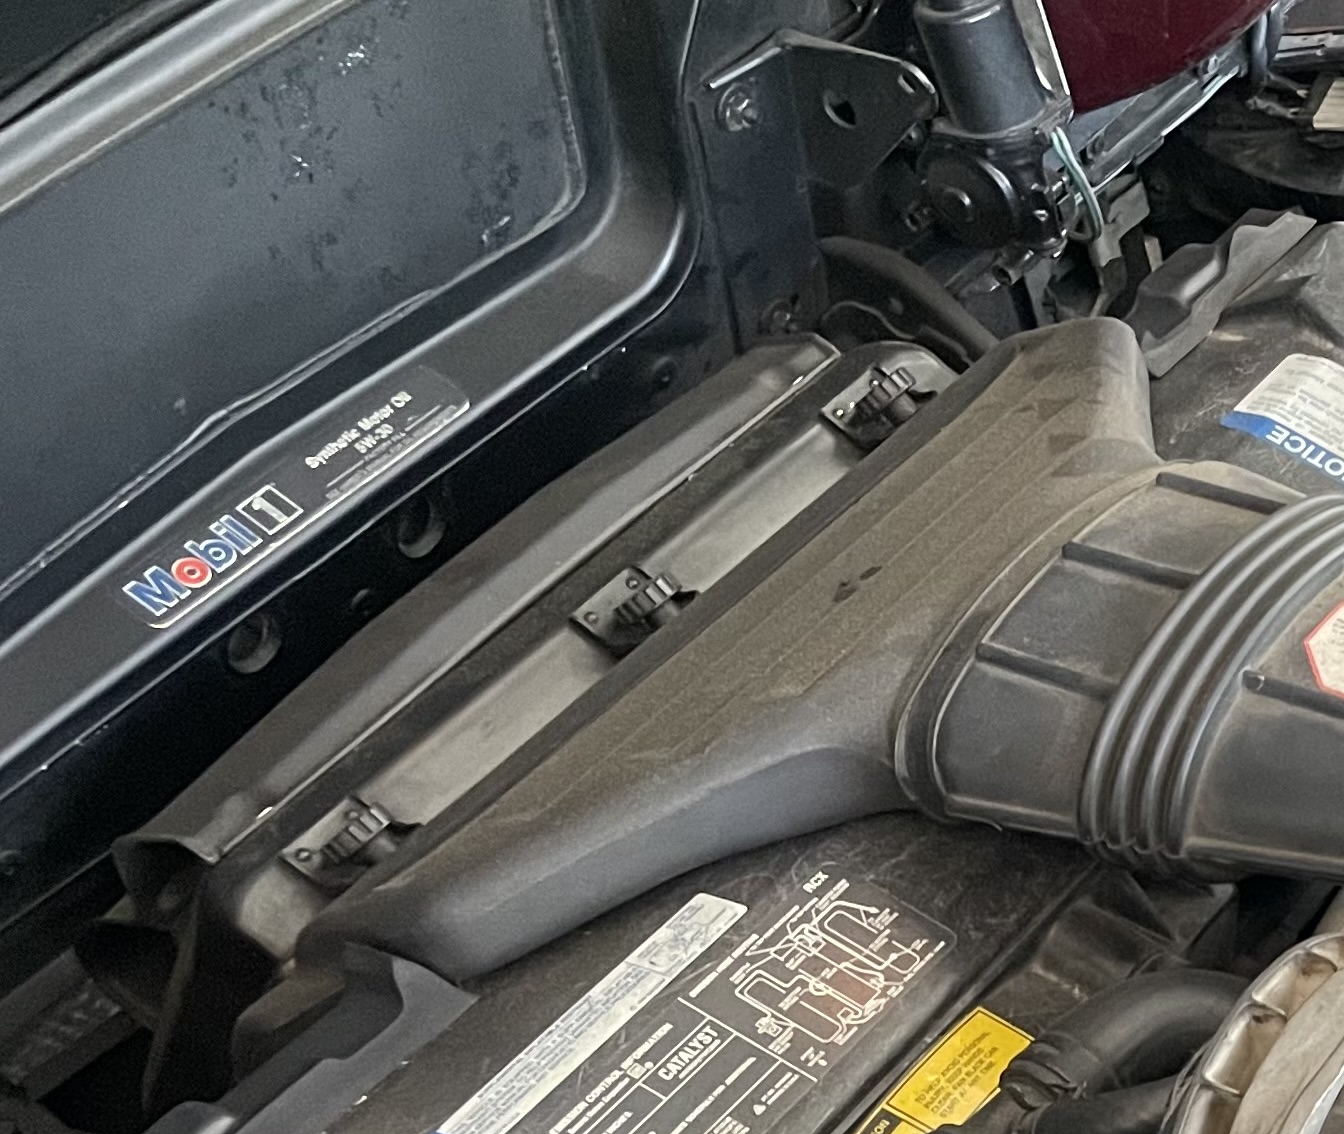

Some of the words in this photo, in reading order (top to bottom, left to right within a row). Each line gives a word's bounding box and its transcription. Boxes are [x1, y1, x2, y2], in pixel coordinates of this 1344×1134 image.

[305, 428, 361, 469] Synthetic
[121, 513, 264, 617] Mobil
[802, 869, 829, 894] RCX
[657, 1024, 719, 1081] CATALYST
